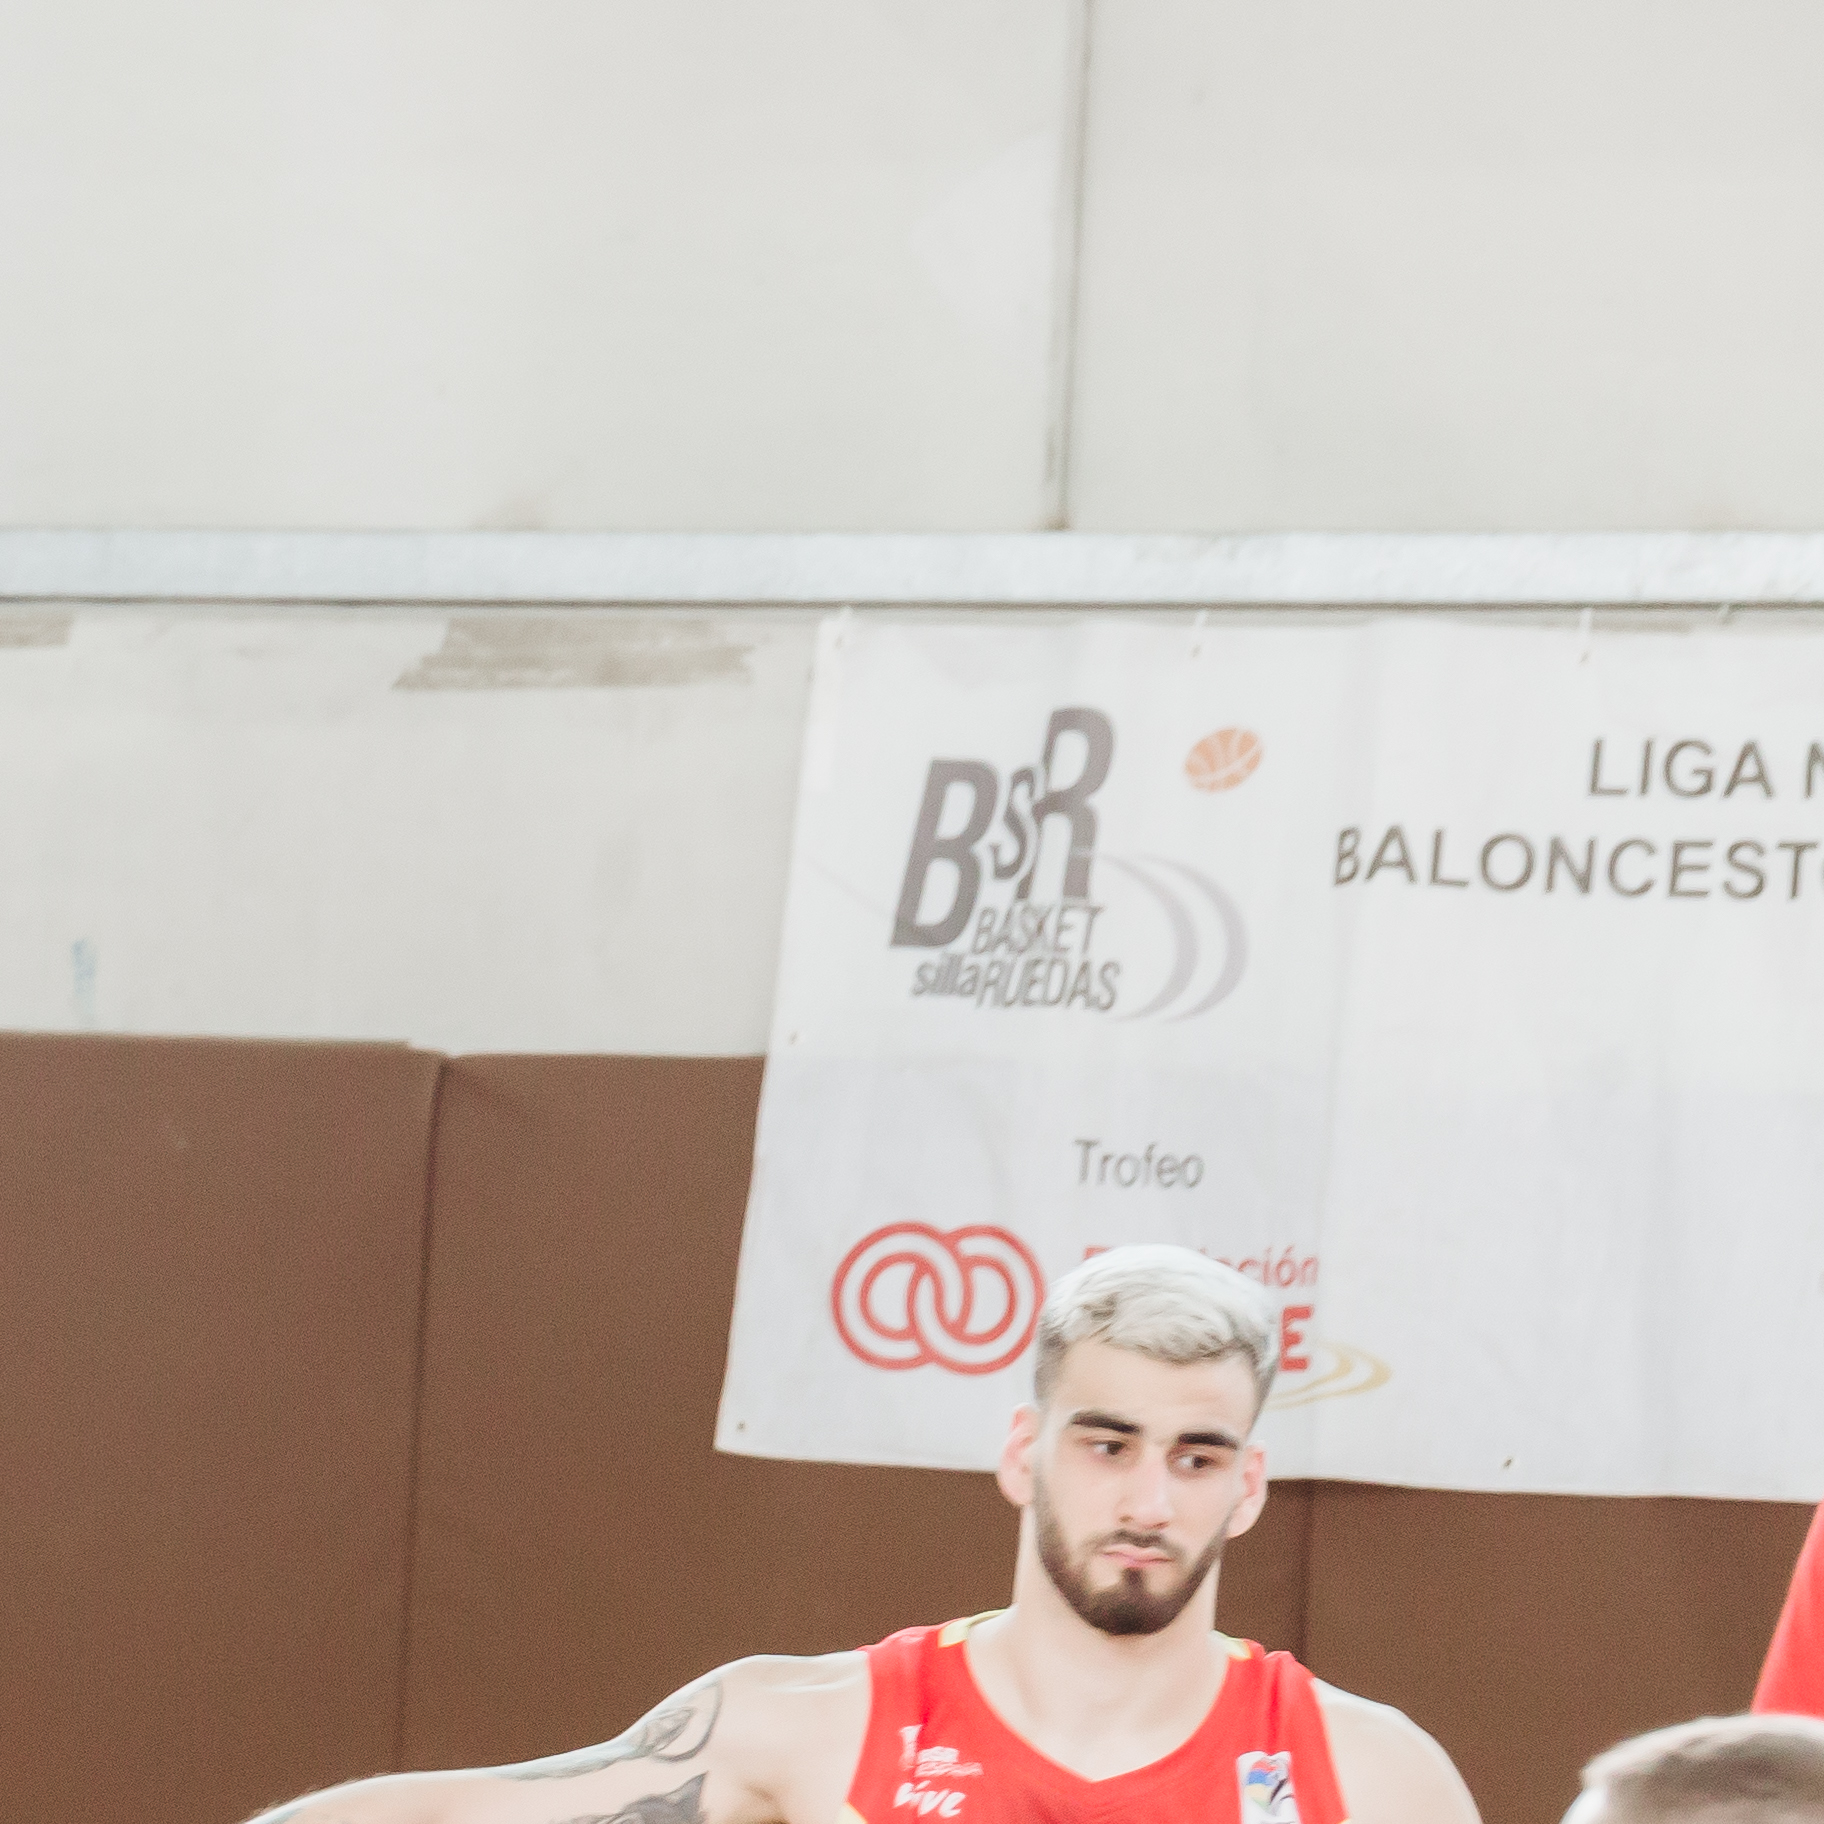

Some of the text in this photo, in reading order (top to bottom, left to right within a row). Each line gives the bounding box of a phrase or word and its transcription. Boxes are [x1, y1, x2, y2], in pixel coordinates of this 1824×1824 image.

[1587, 737, 1775, 799] LIGA
[889, 706, 1116, 949] BSR
[1332, 824, 1824, 900] BALONCEST
[970, 902, 1106, 956] BASKET
[1074, 1138, 1205, 1189] Trofeo
